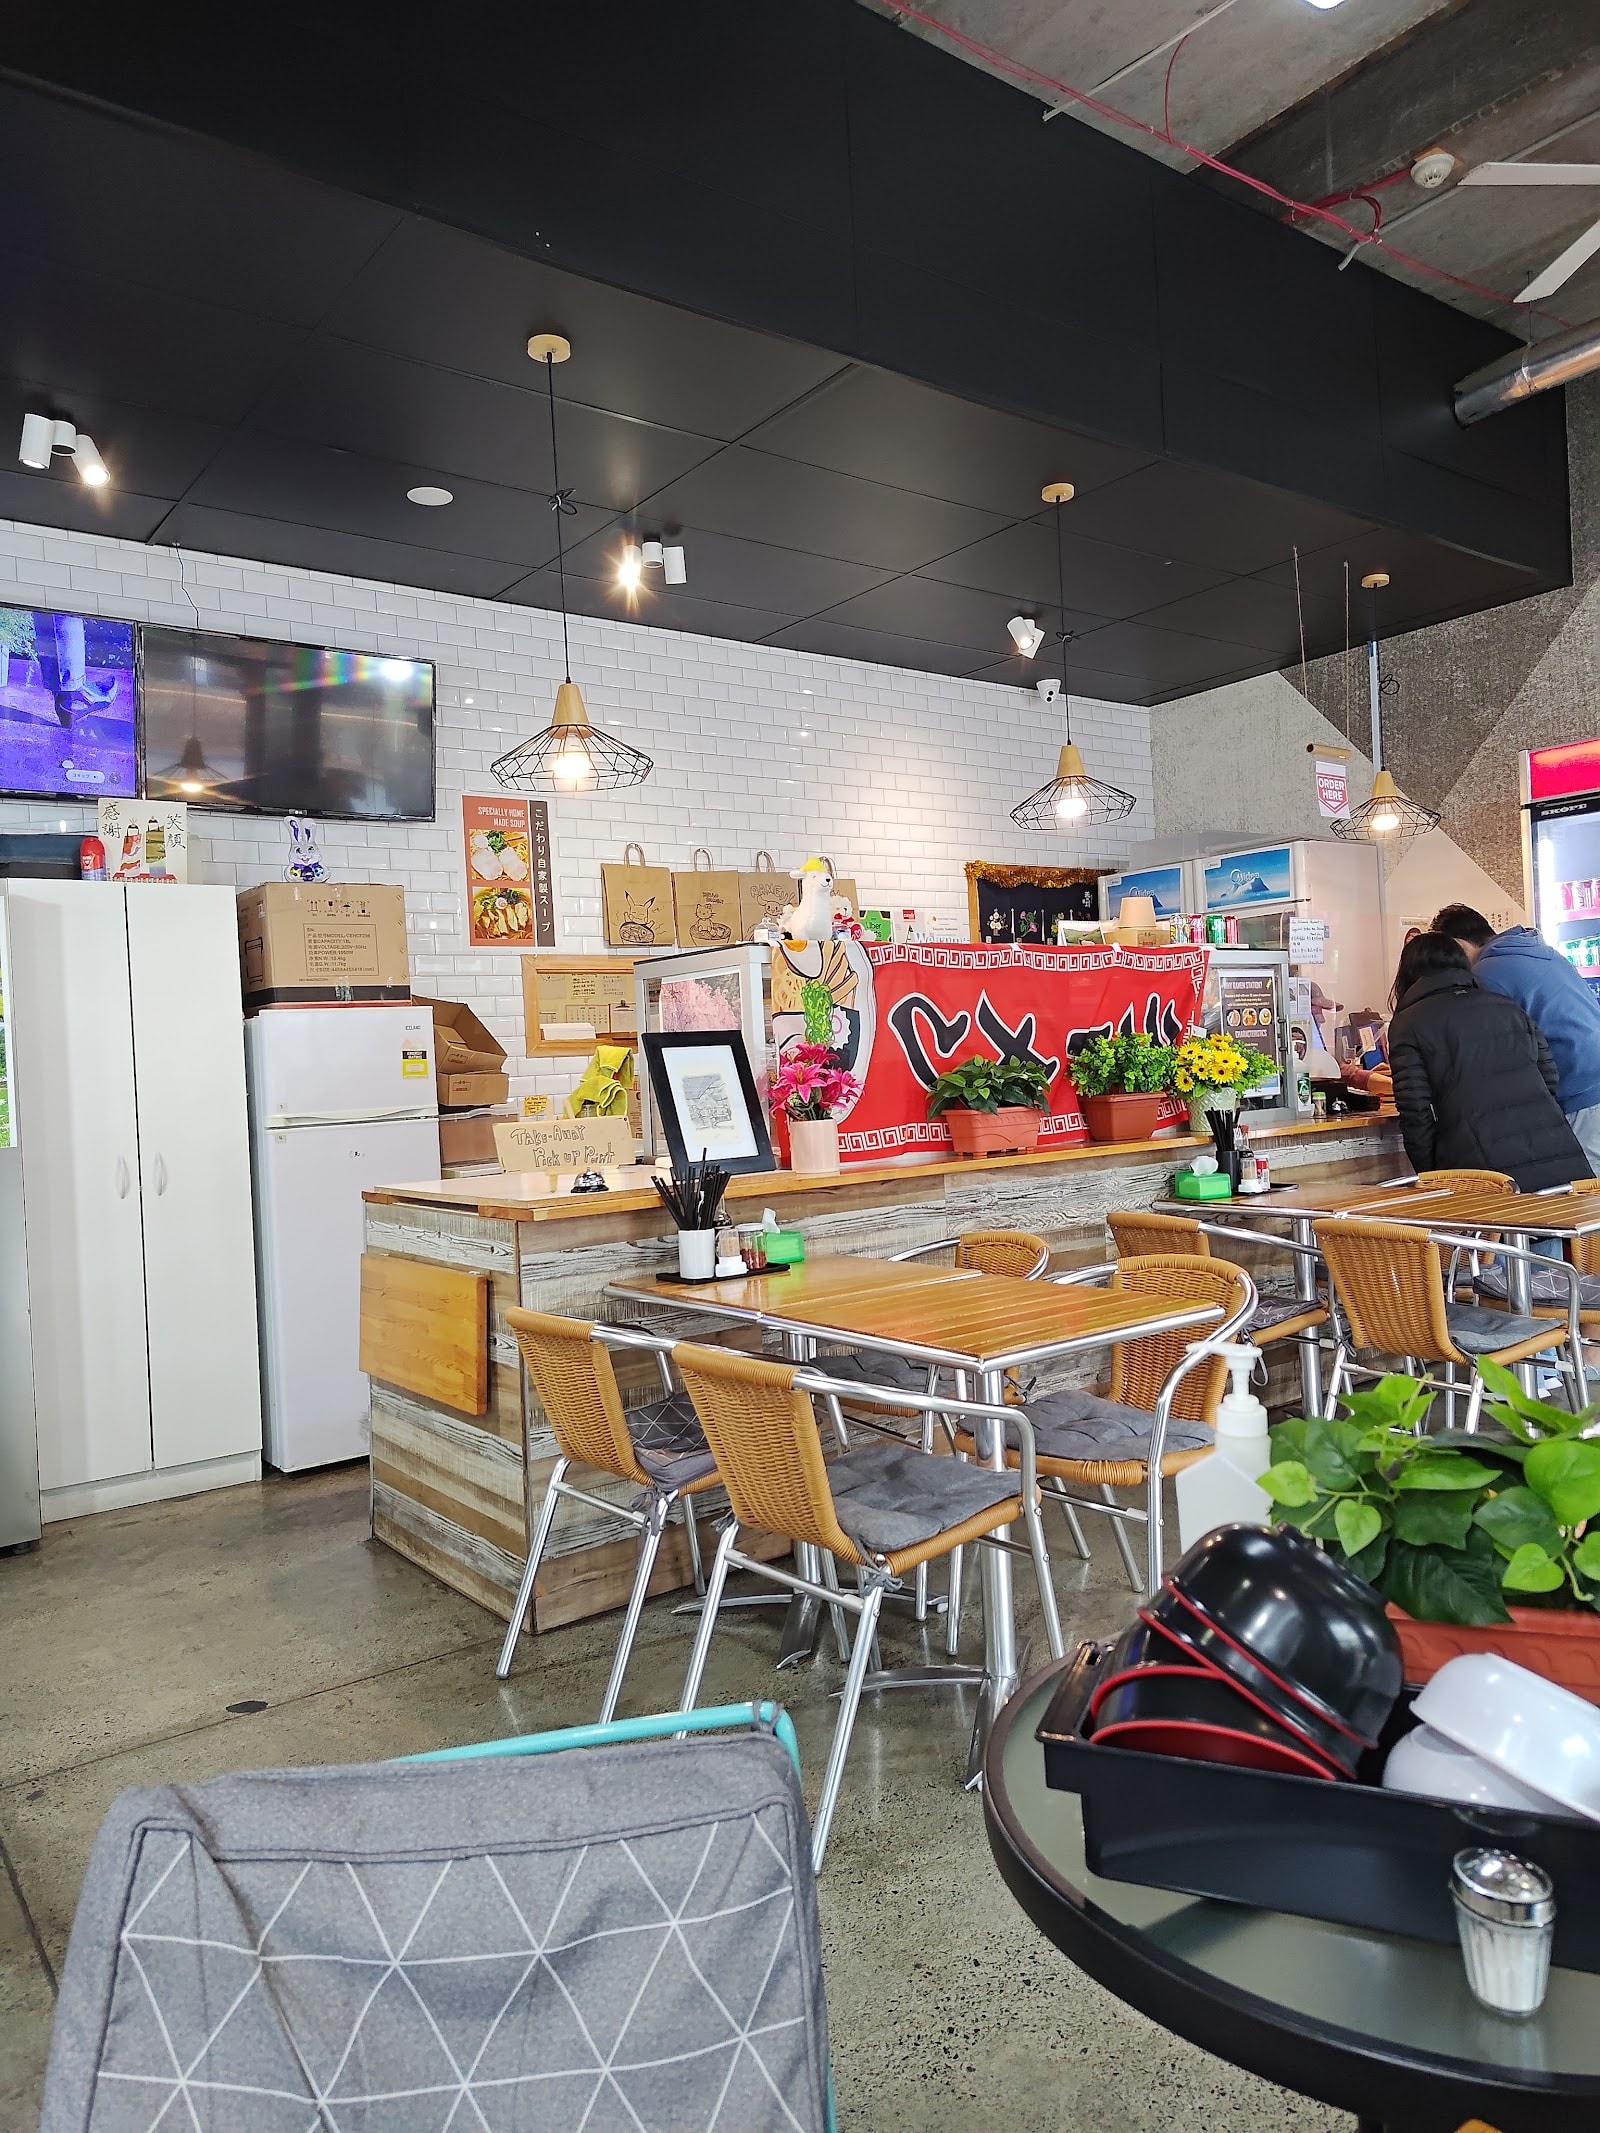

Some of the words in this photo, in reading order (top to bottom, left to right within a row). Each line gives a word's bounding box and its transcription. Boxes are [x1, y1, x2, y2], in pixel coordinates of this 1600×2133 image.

[1318, 778, 1345, 790] ORDER
[1322, 789, 1343, 801] HERE
[478, 806, 508, 817] SPECIALLY
[508, 808, 525, 818] HOME
[1540, 803, 1588, 817] SKOPE
[101, 801, 121, 839] 感謝
[493, 818, 509, 827] MADE
[509, 819, 526, 829] SOUP
[166, 813, 186, 849] 笑顔
[535, 808, 550, 932] こだわり自家製スープ
[1230, 868, 1260, 886] Midea
[866, 921, 881, 929] Uber
